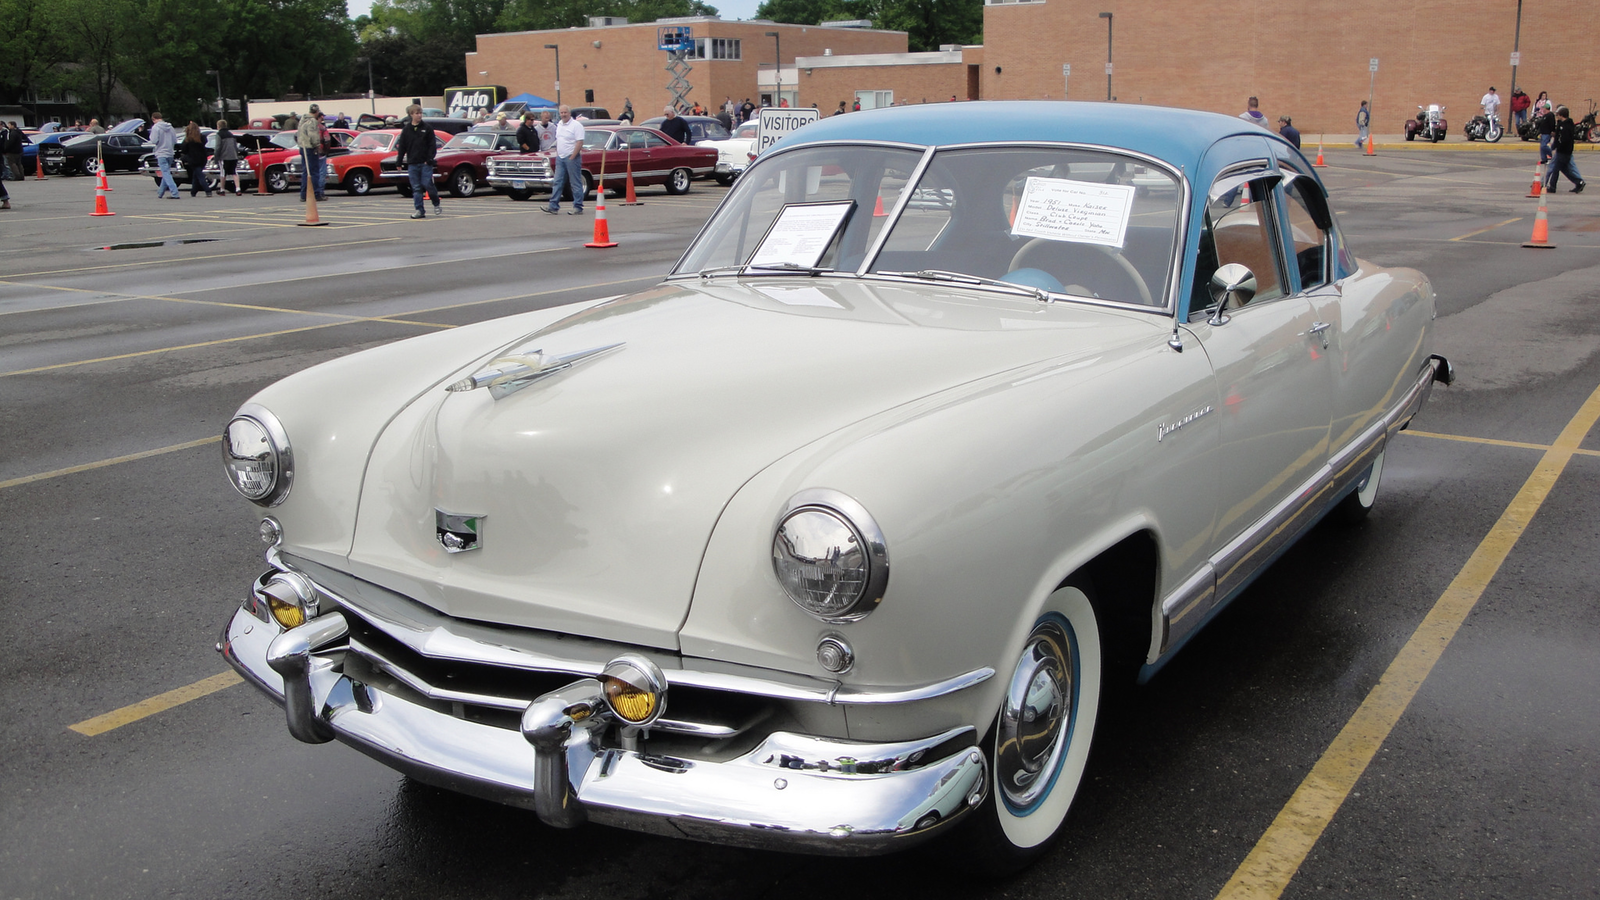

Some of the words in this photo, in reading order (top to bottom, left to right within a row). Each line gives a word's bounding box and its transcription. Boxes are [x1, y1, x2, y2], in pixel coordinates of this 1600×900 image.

[450, 91, 489, 107] Auto
[1039, 215, 1057, 224] Brad
[1049, 211, 1067, 219] Club
